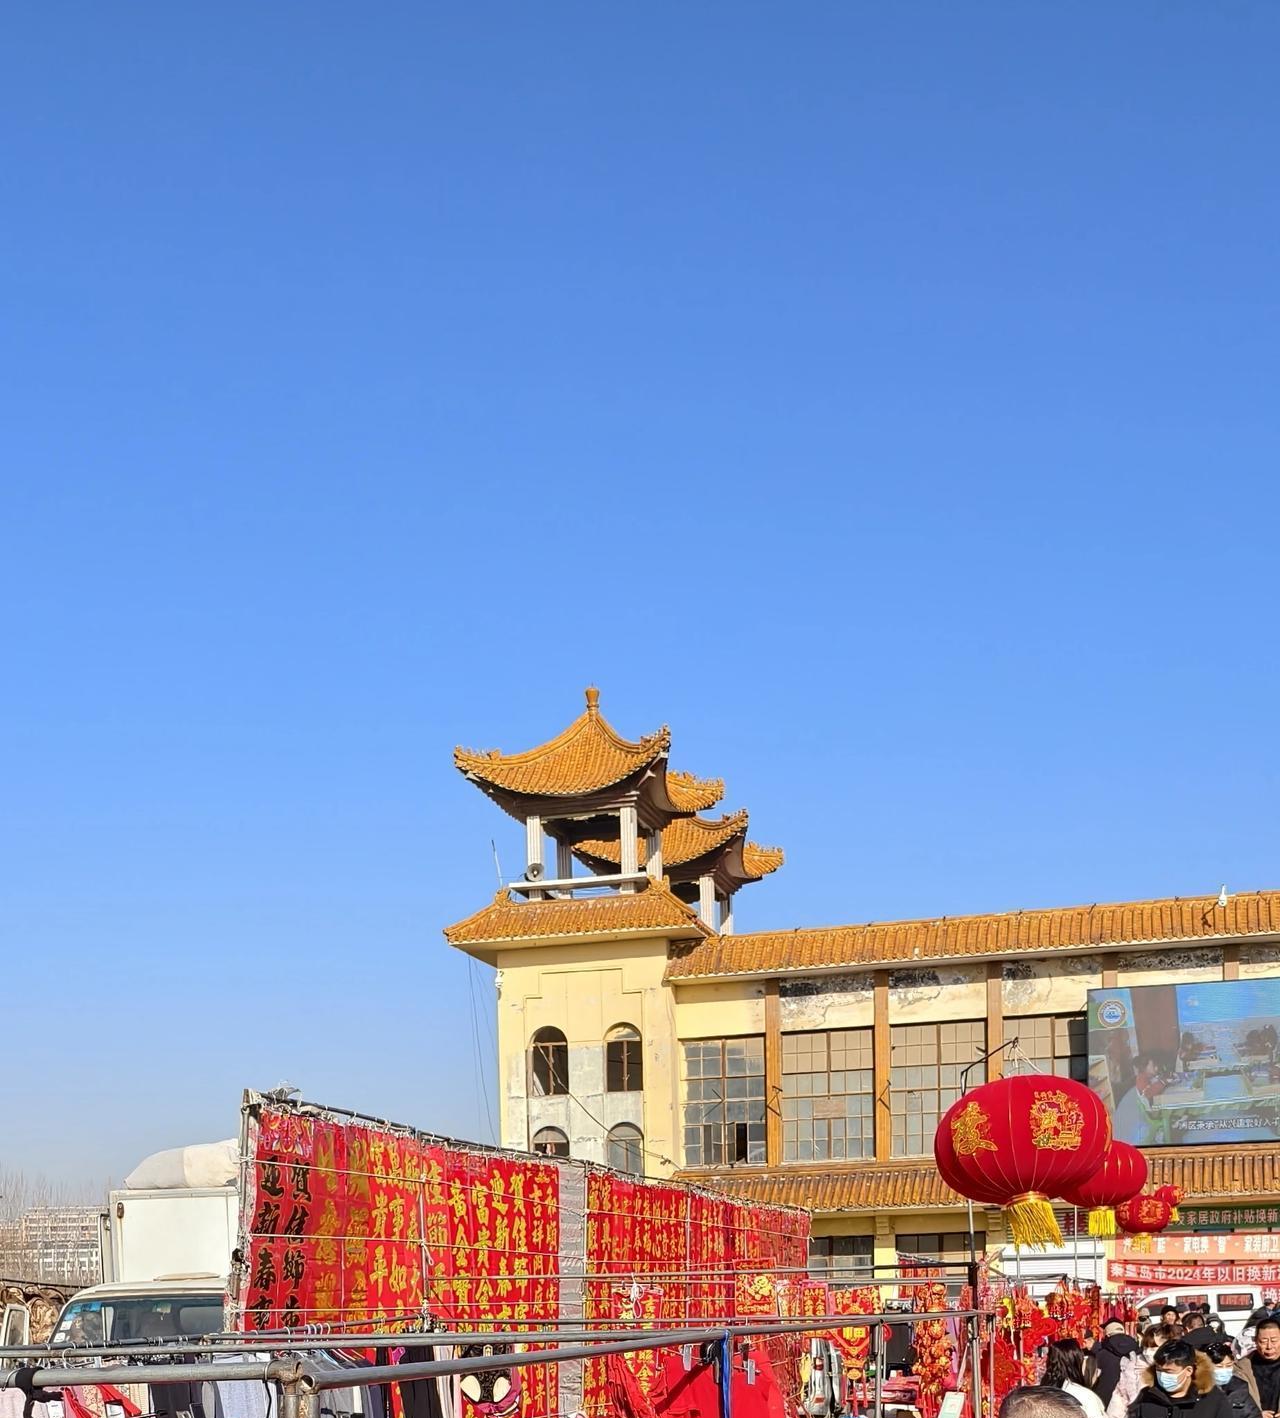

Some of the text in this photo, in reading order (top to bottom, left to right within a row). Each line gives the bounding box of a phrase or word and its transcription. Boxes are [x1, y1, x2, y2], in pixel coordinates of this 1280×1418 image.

[1110, 1263, 1280, 1282] 秦皇岛市2024年以旧换新
